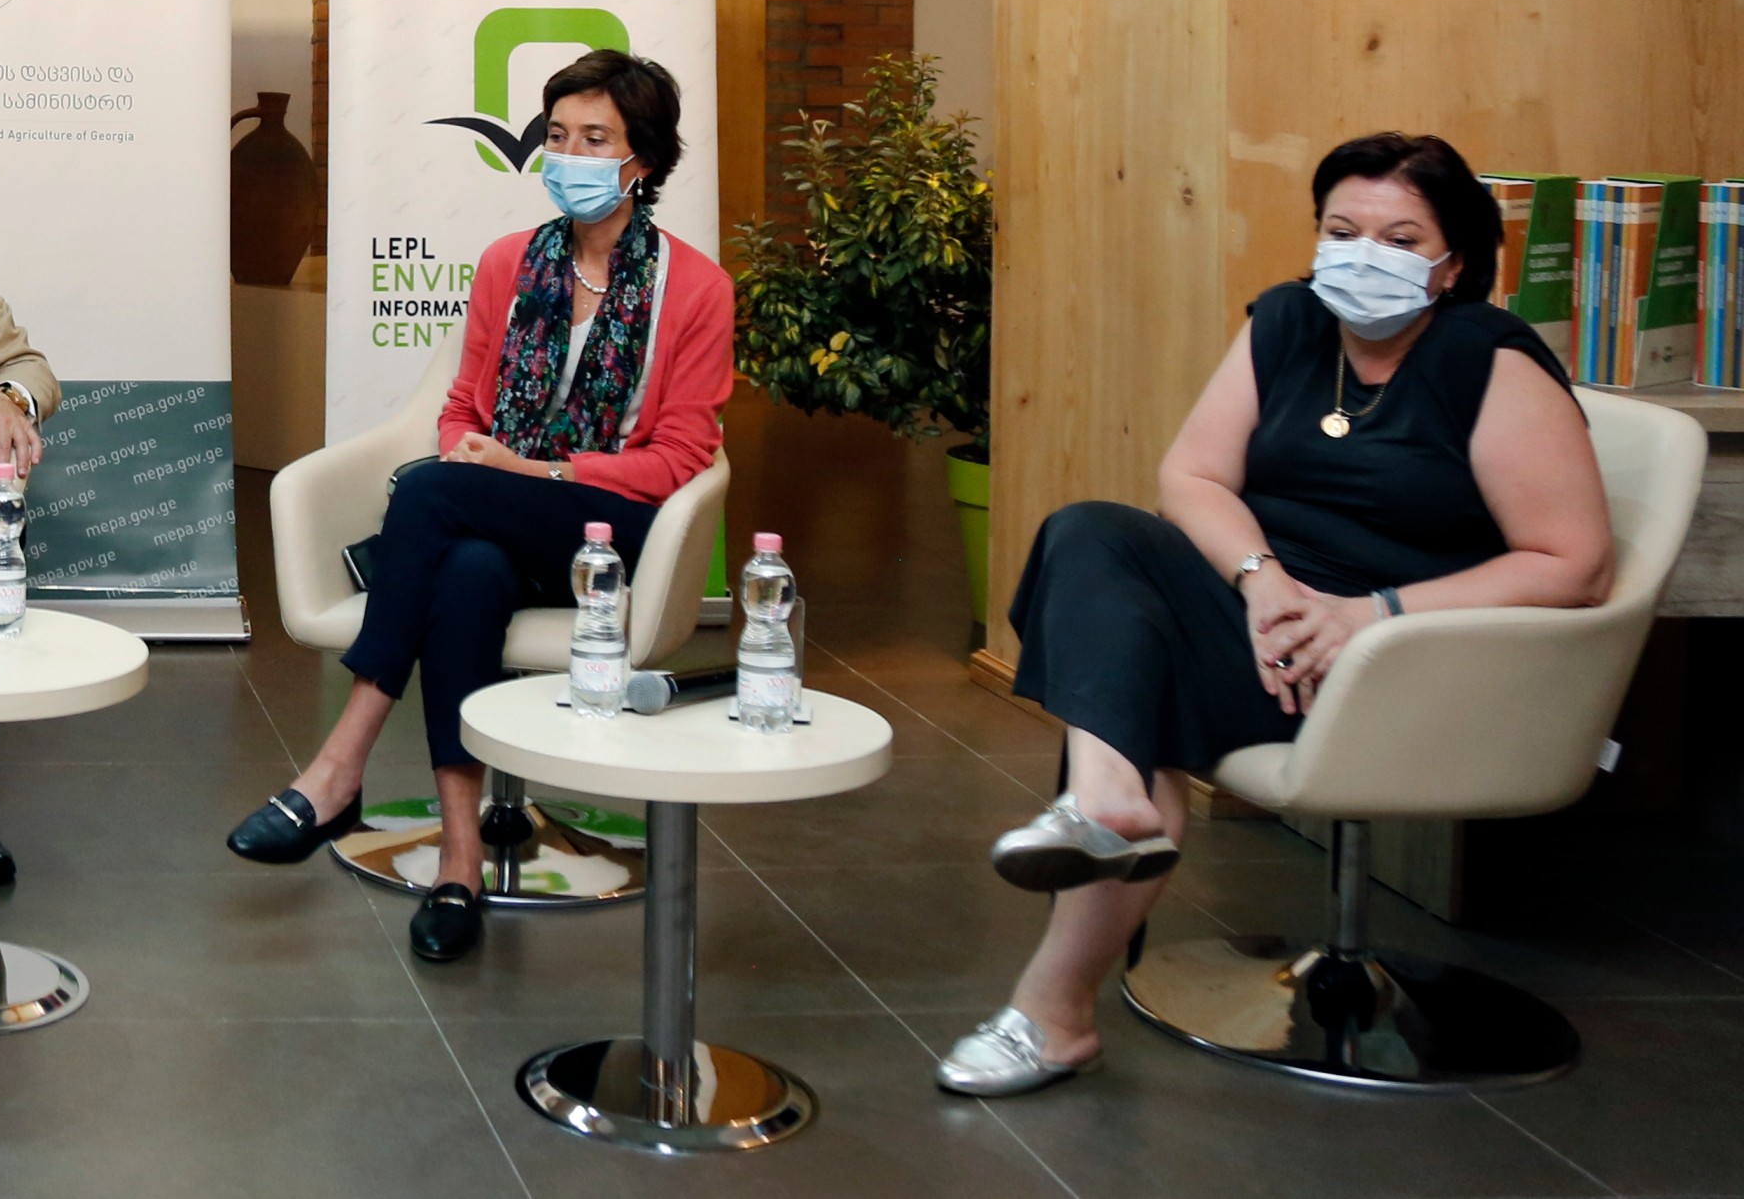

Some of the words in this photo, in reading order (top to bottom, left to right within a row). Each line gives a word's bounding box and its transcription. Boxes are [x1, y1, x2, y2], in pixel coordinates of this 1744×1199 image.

[20, 65, 103, 83] დაცვისა
[107, 66, 135, 83] და
[3, 92, 134, 111] სამინისტრო
[8, 129, 72, 143] Agriculture
[76, 130, 87, 141] of
[91, 130, 135, 143] Georgia
[372, 237, 435, 259] LEPL
[113, 385, 205, 424] mepa.gov.ge
[66, 438, 157, 476] mepa.gov.ge
[132, 446, 224, 485] mepa.gov.ge
[86, 498, 177, 538] mepa.gov.ge
